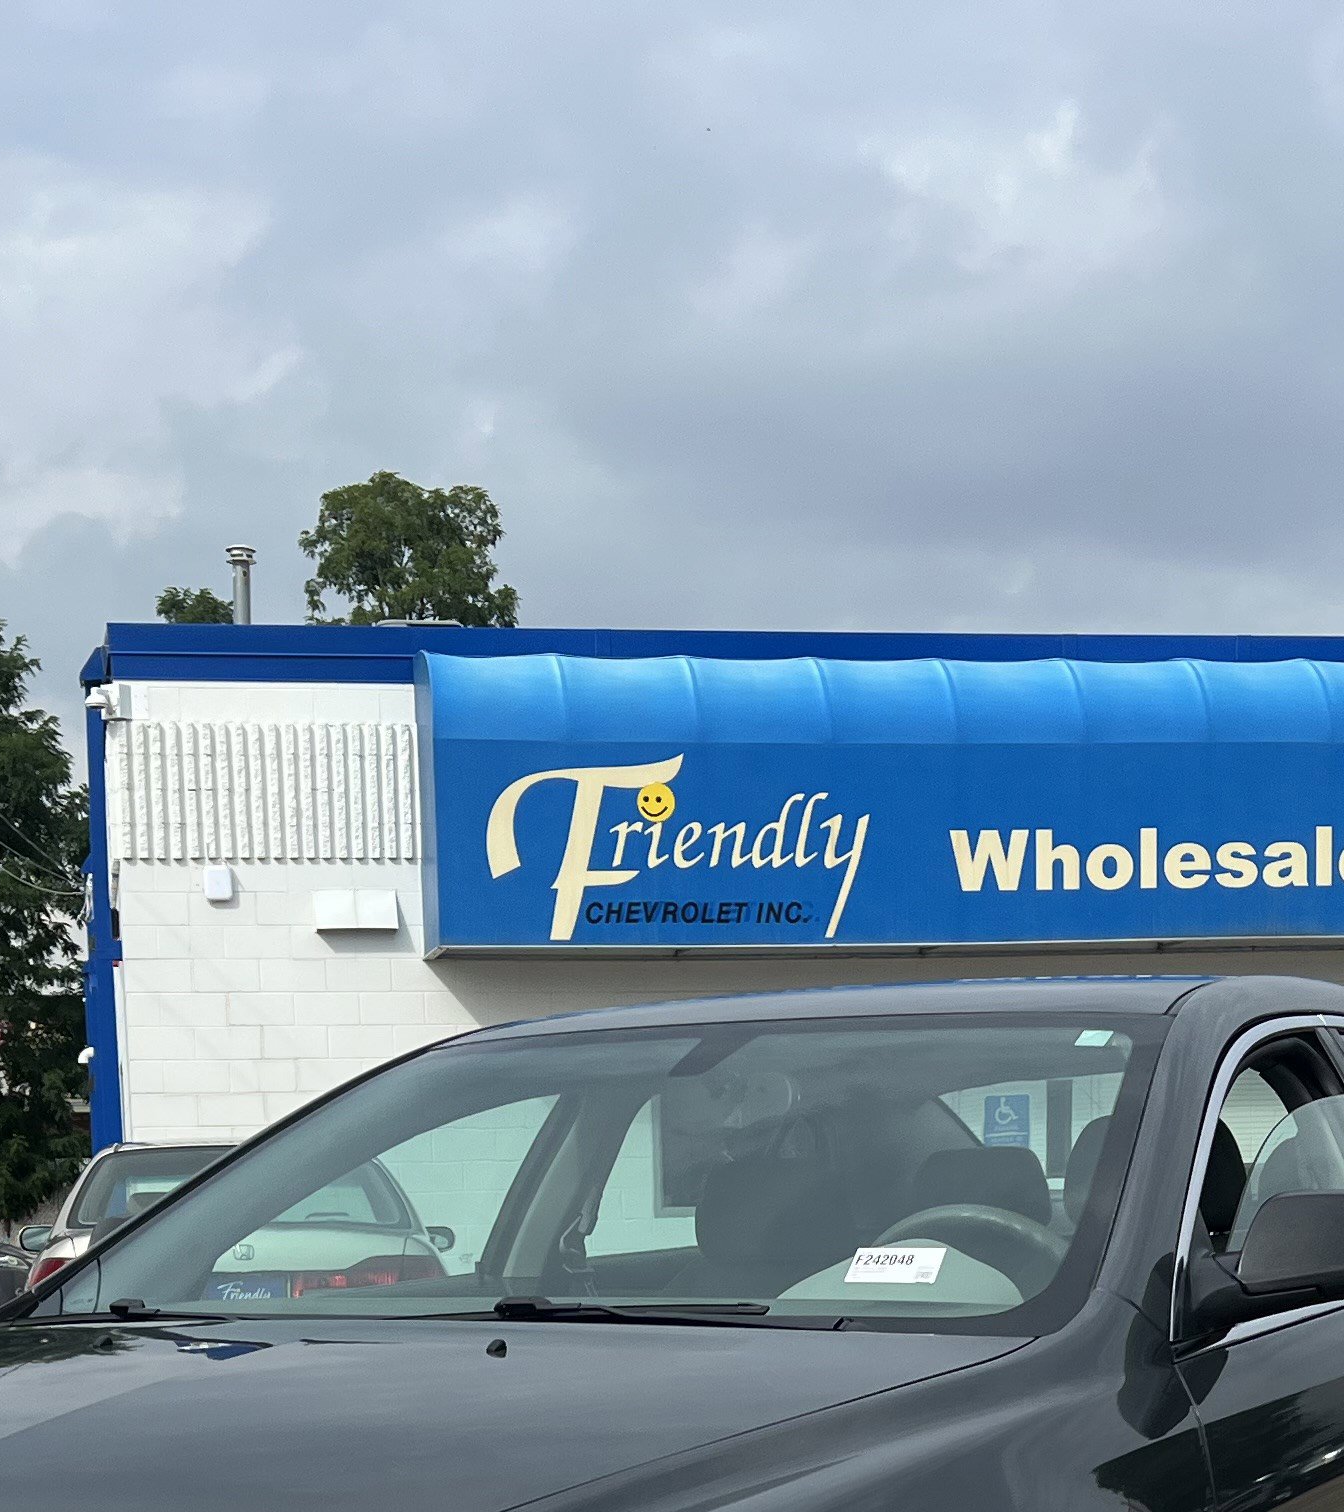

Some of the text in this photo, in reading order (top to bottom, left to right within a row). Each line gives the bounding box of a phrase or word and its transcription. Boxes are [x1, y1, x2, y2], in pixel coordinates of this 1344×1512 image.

[485, 752, 871, 941] Friendly
[585, 901, 810, 924] CHEVROLET INC.
[855, 1254, 915, 1266] F242048
